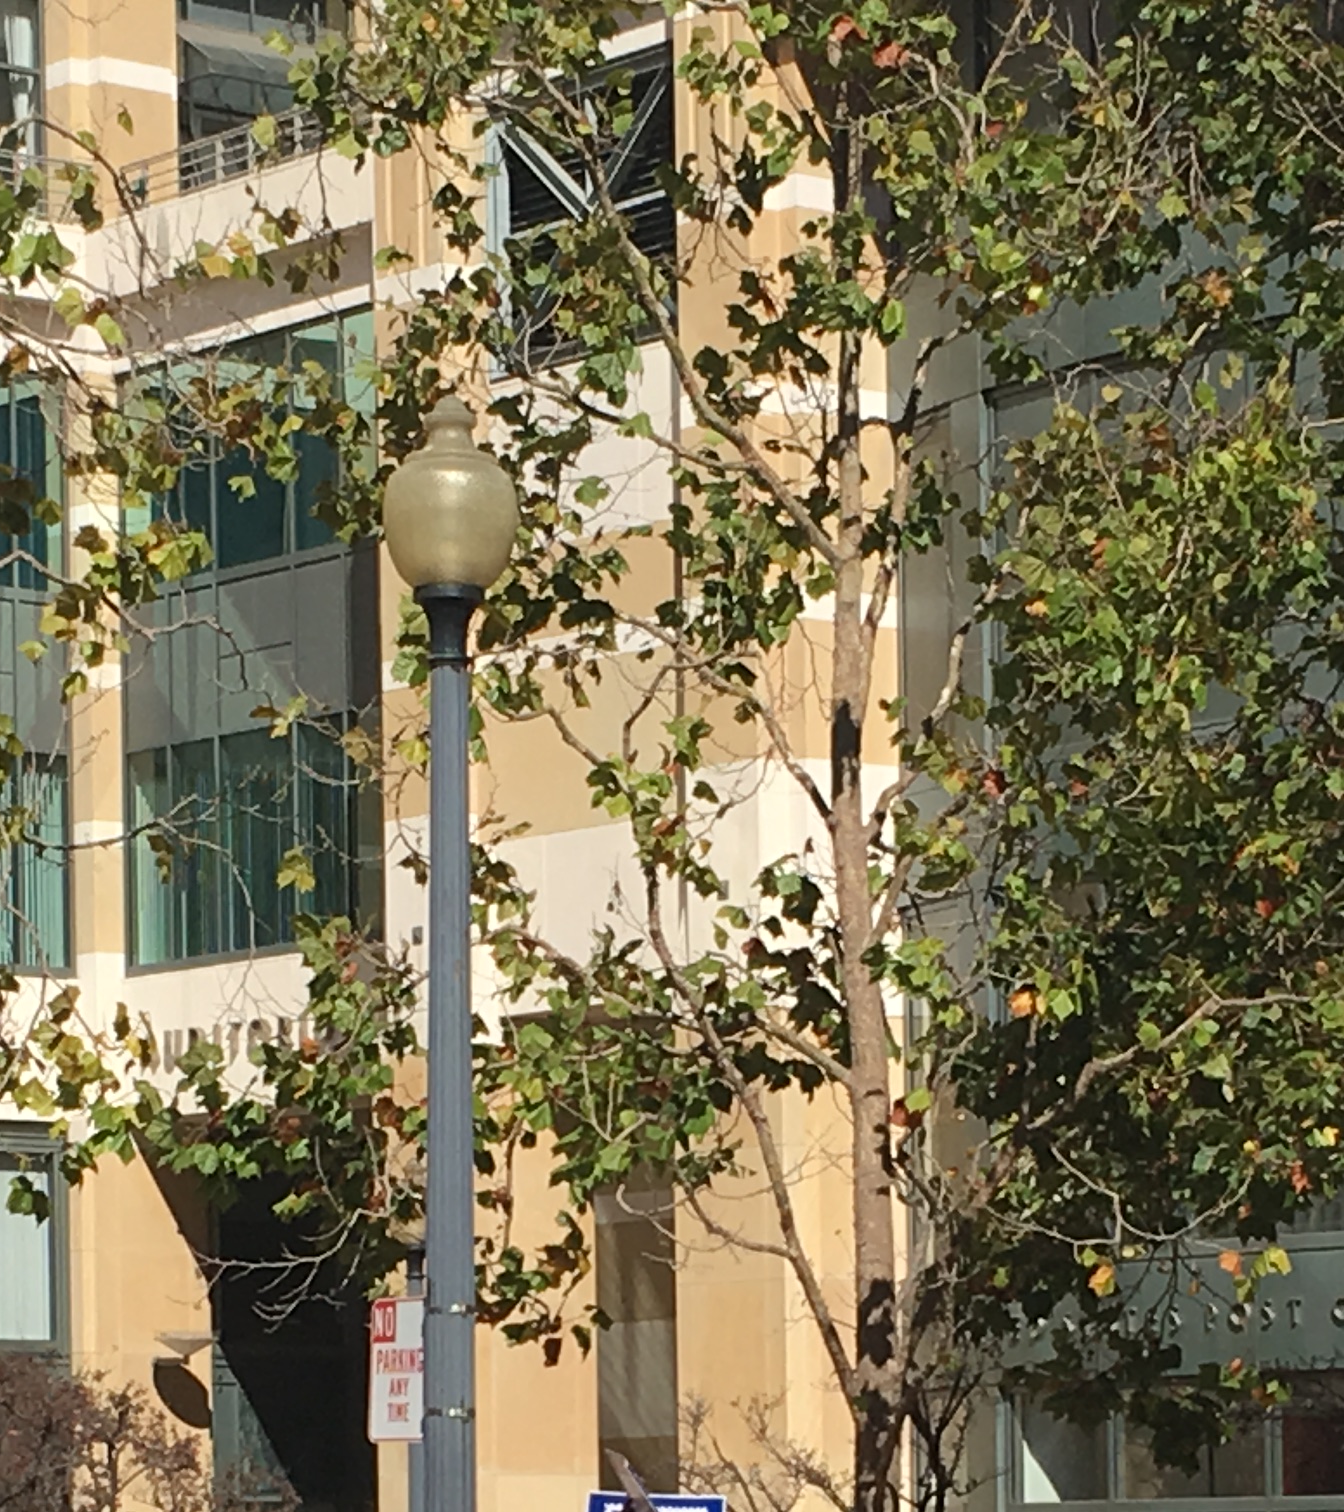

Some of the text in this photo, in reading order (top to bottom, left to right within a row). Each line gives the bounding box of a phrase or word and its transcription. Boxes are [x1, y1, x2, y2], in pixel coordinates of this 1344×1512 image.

[373, 1306, 394, 1338] NO
[1204, 1298, 1303, 1334] POST
[376, 1348, 424, 1373] PARKING
[389, 1378, 410, 1396] ANY
[387, 1402, 410, 1422] TIME
